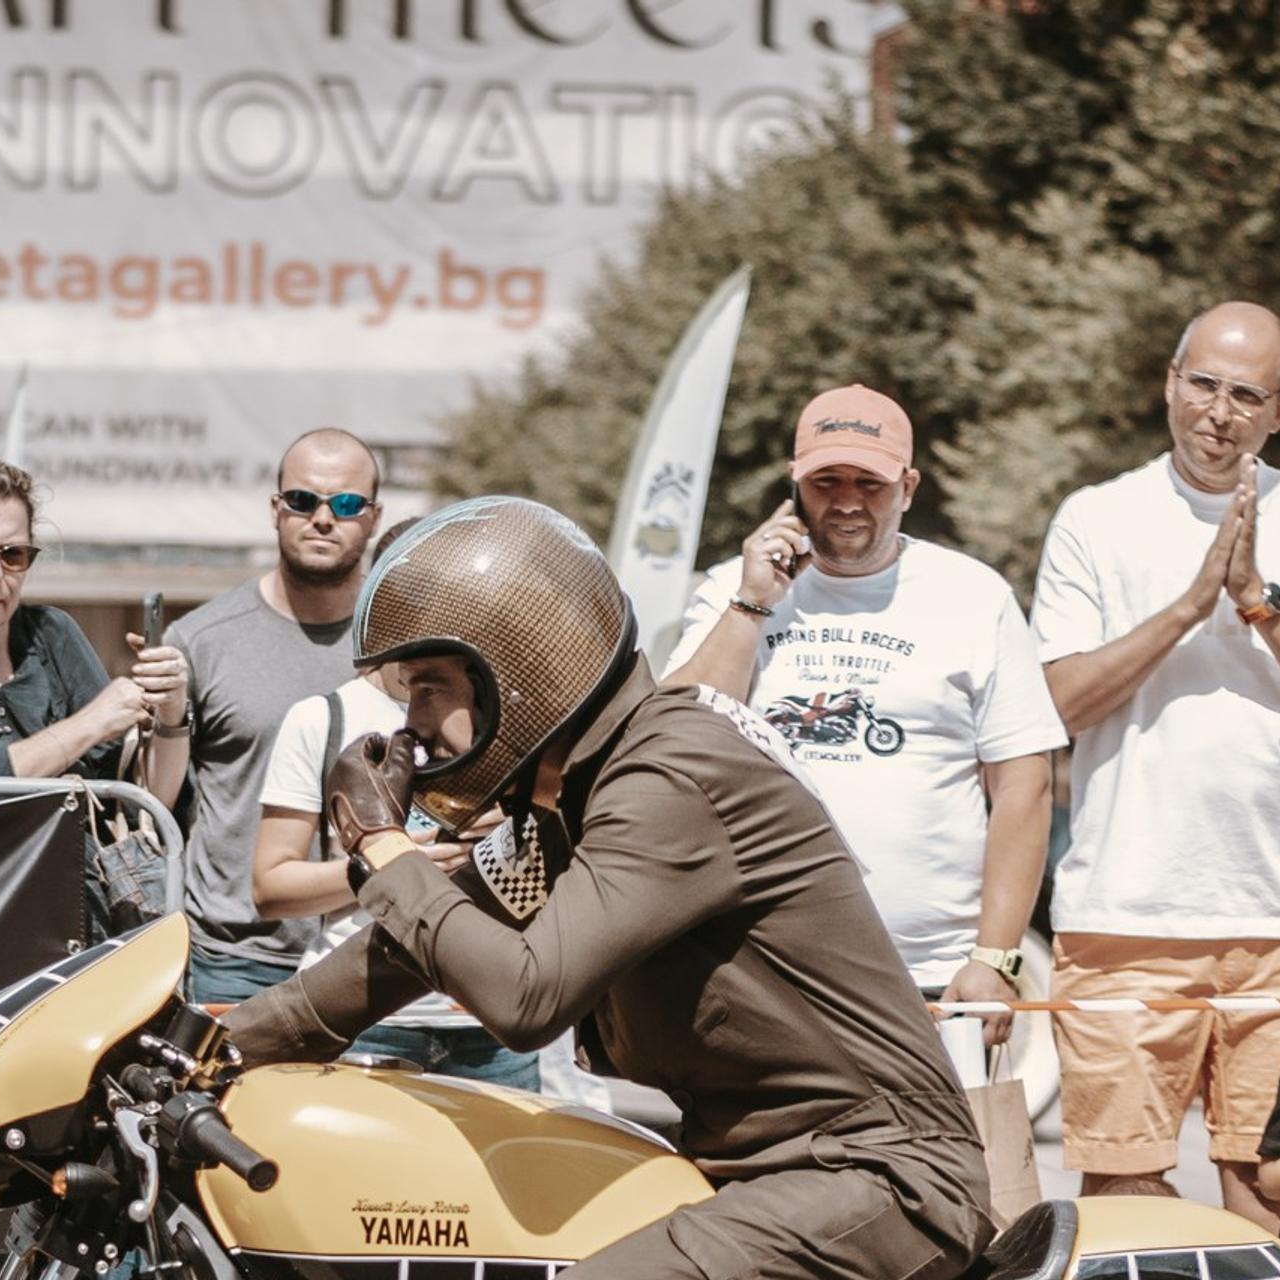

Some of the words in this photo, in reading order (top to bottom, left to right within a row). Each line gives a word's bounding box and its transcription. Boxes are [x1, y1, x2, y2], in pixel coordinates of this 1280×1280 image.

[821, 628, 856, 644] BULL
[861, 631, 916, 657] RACERS
[795, 654, 825, 667] FULL
[832, 655, 892, 673] THROTTLE
[360, 1216, 470, 1247] YAMAHA
